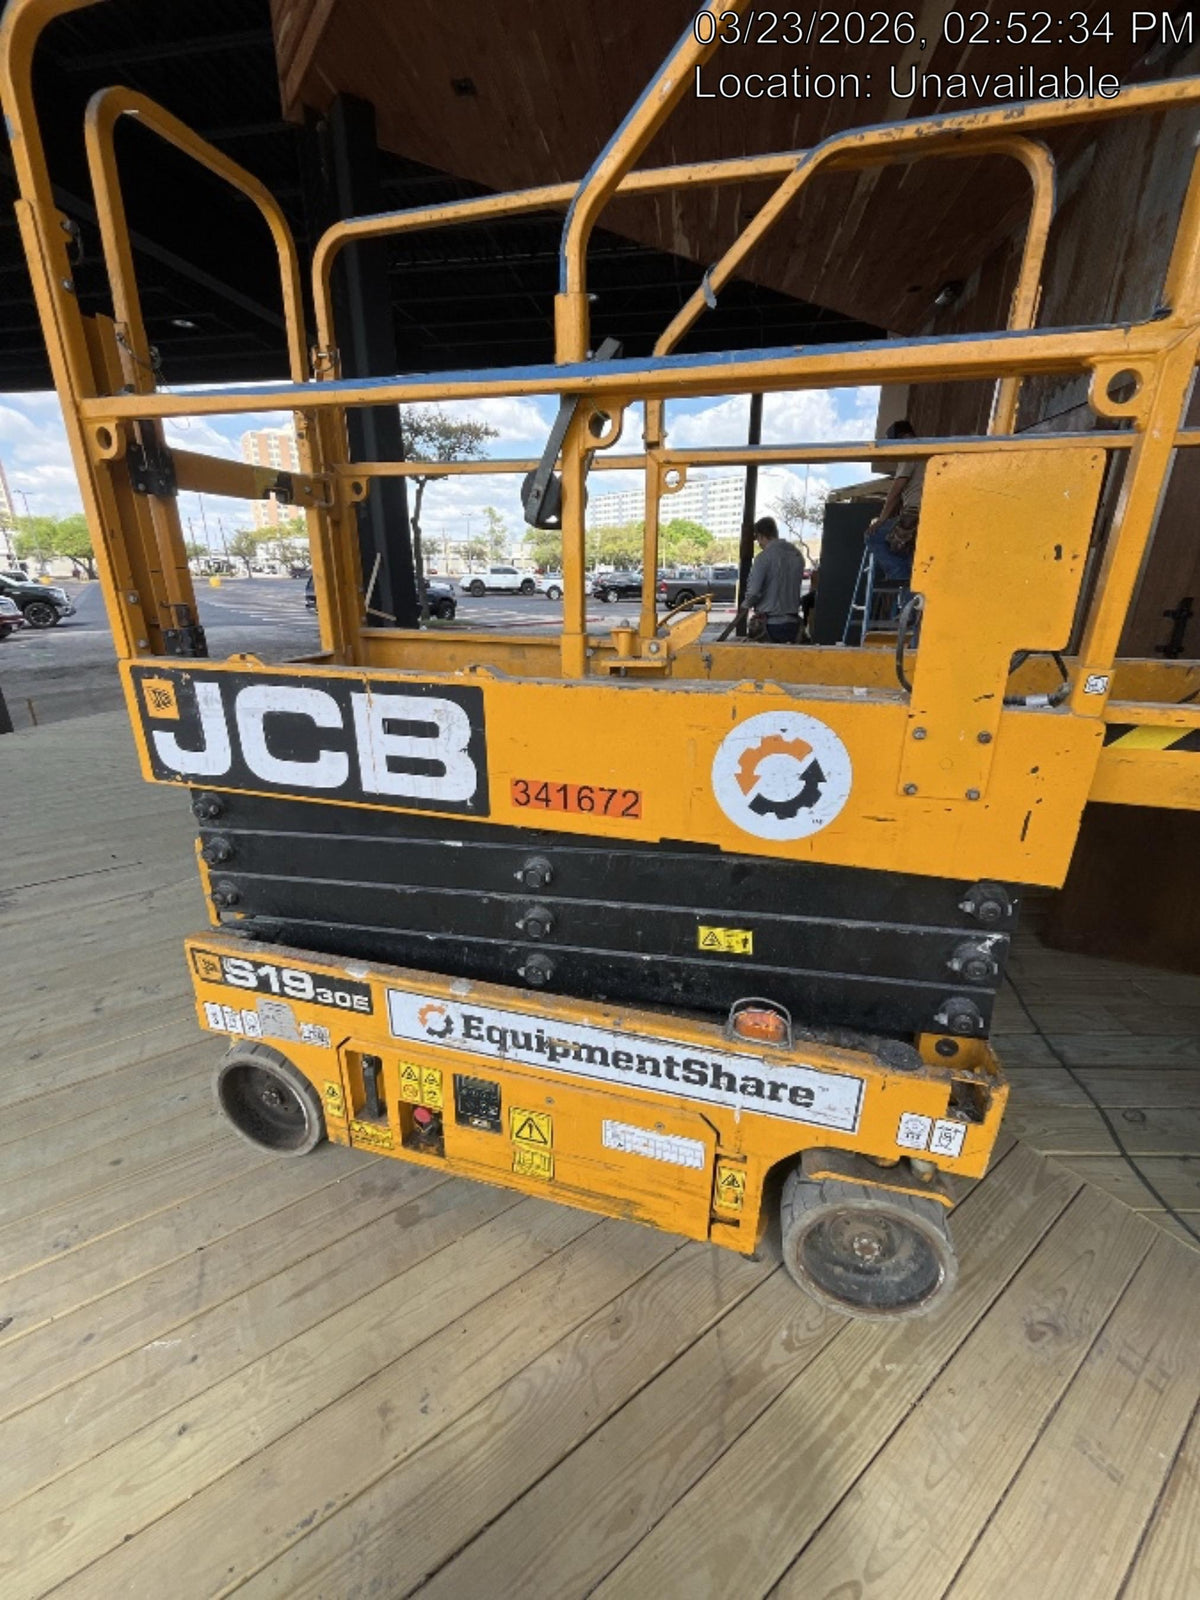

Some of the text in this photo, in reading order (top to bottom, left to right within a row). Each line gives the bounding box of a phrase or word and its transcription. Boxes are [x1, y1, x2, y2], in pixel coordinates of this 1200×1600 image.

[152, 681, 478, 802] JCB
[513, 779, 640, 819] 341672
[461, 1013, 815, 1108] EquipmentShare
